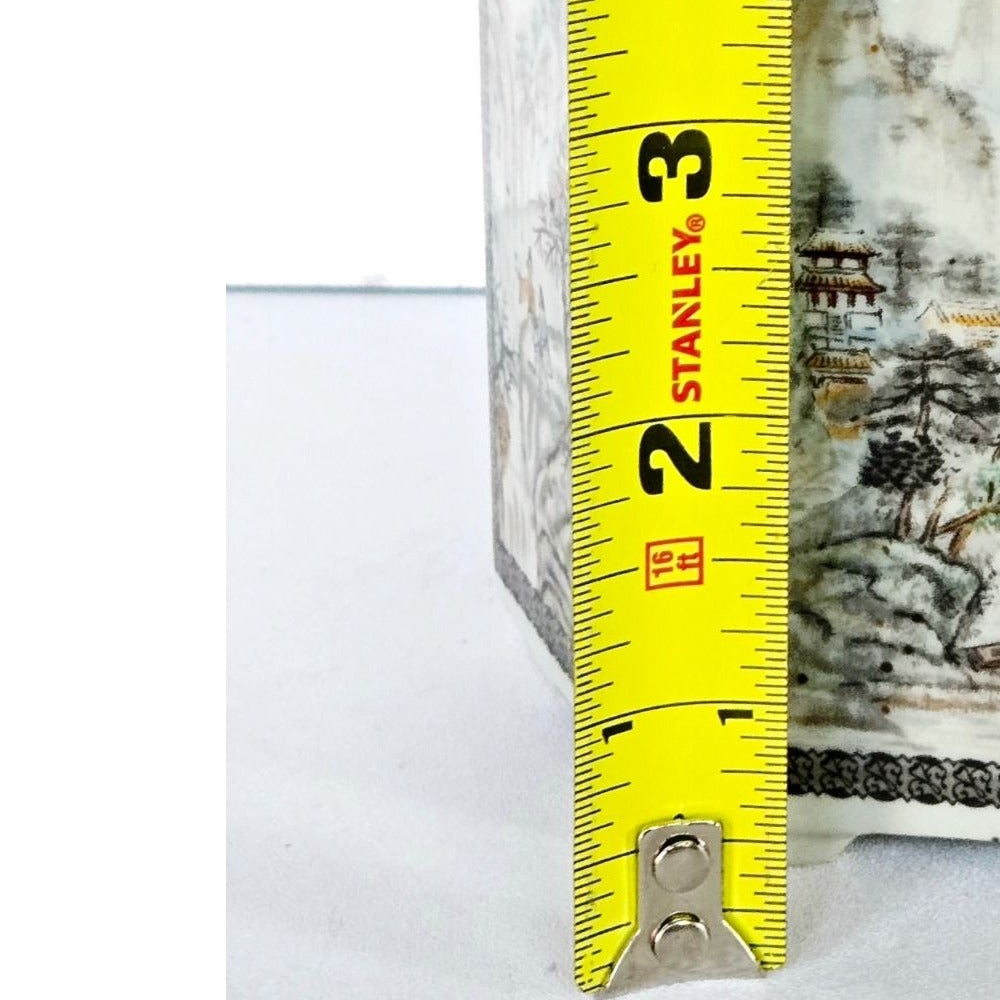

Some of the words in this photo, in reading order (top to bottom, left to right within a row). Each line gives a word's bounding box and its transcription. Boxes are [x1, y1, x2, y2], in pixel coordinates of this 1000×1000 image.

[637, 129, 712, 203] 3
[638, 422, 712, 495] 2
[652, 550, 674, 578] 16
[676, 553, 702, 571] ft
[717, 709, 754, 726] 1
[601, 720, 633, 745] 1
